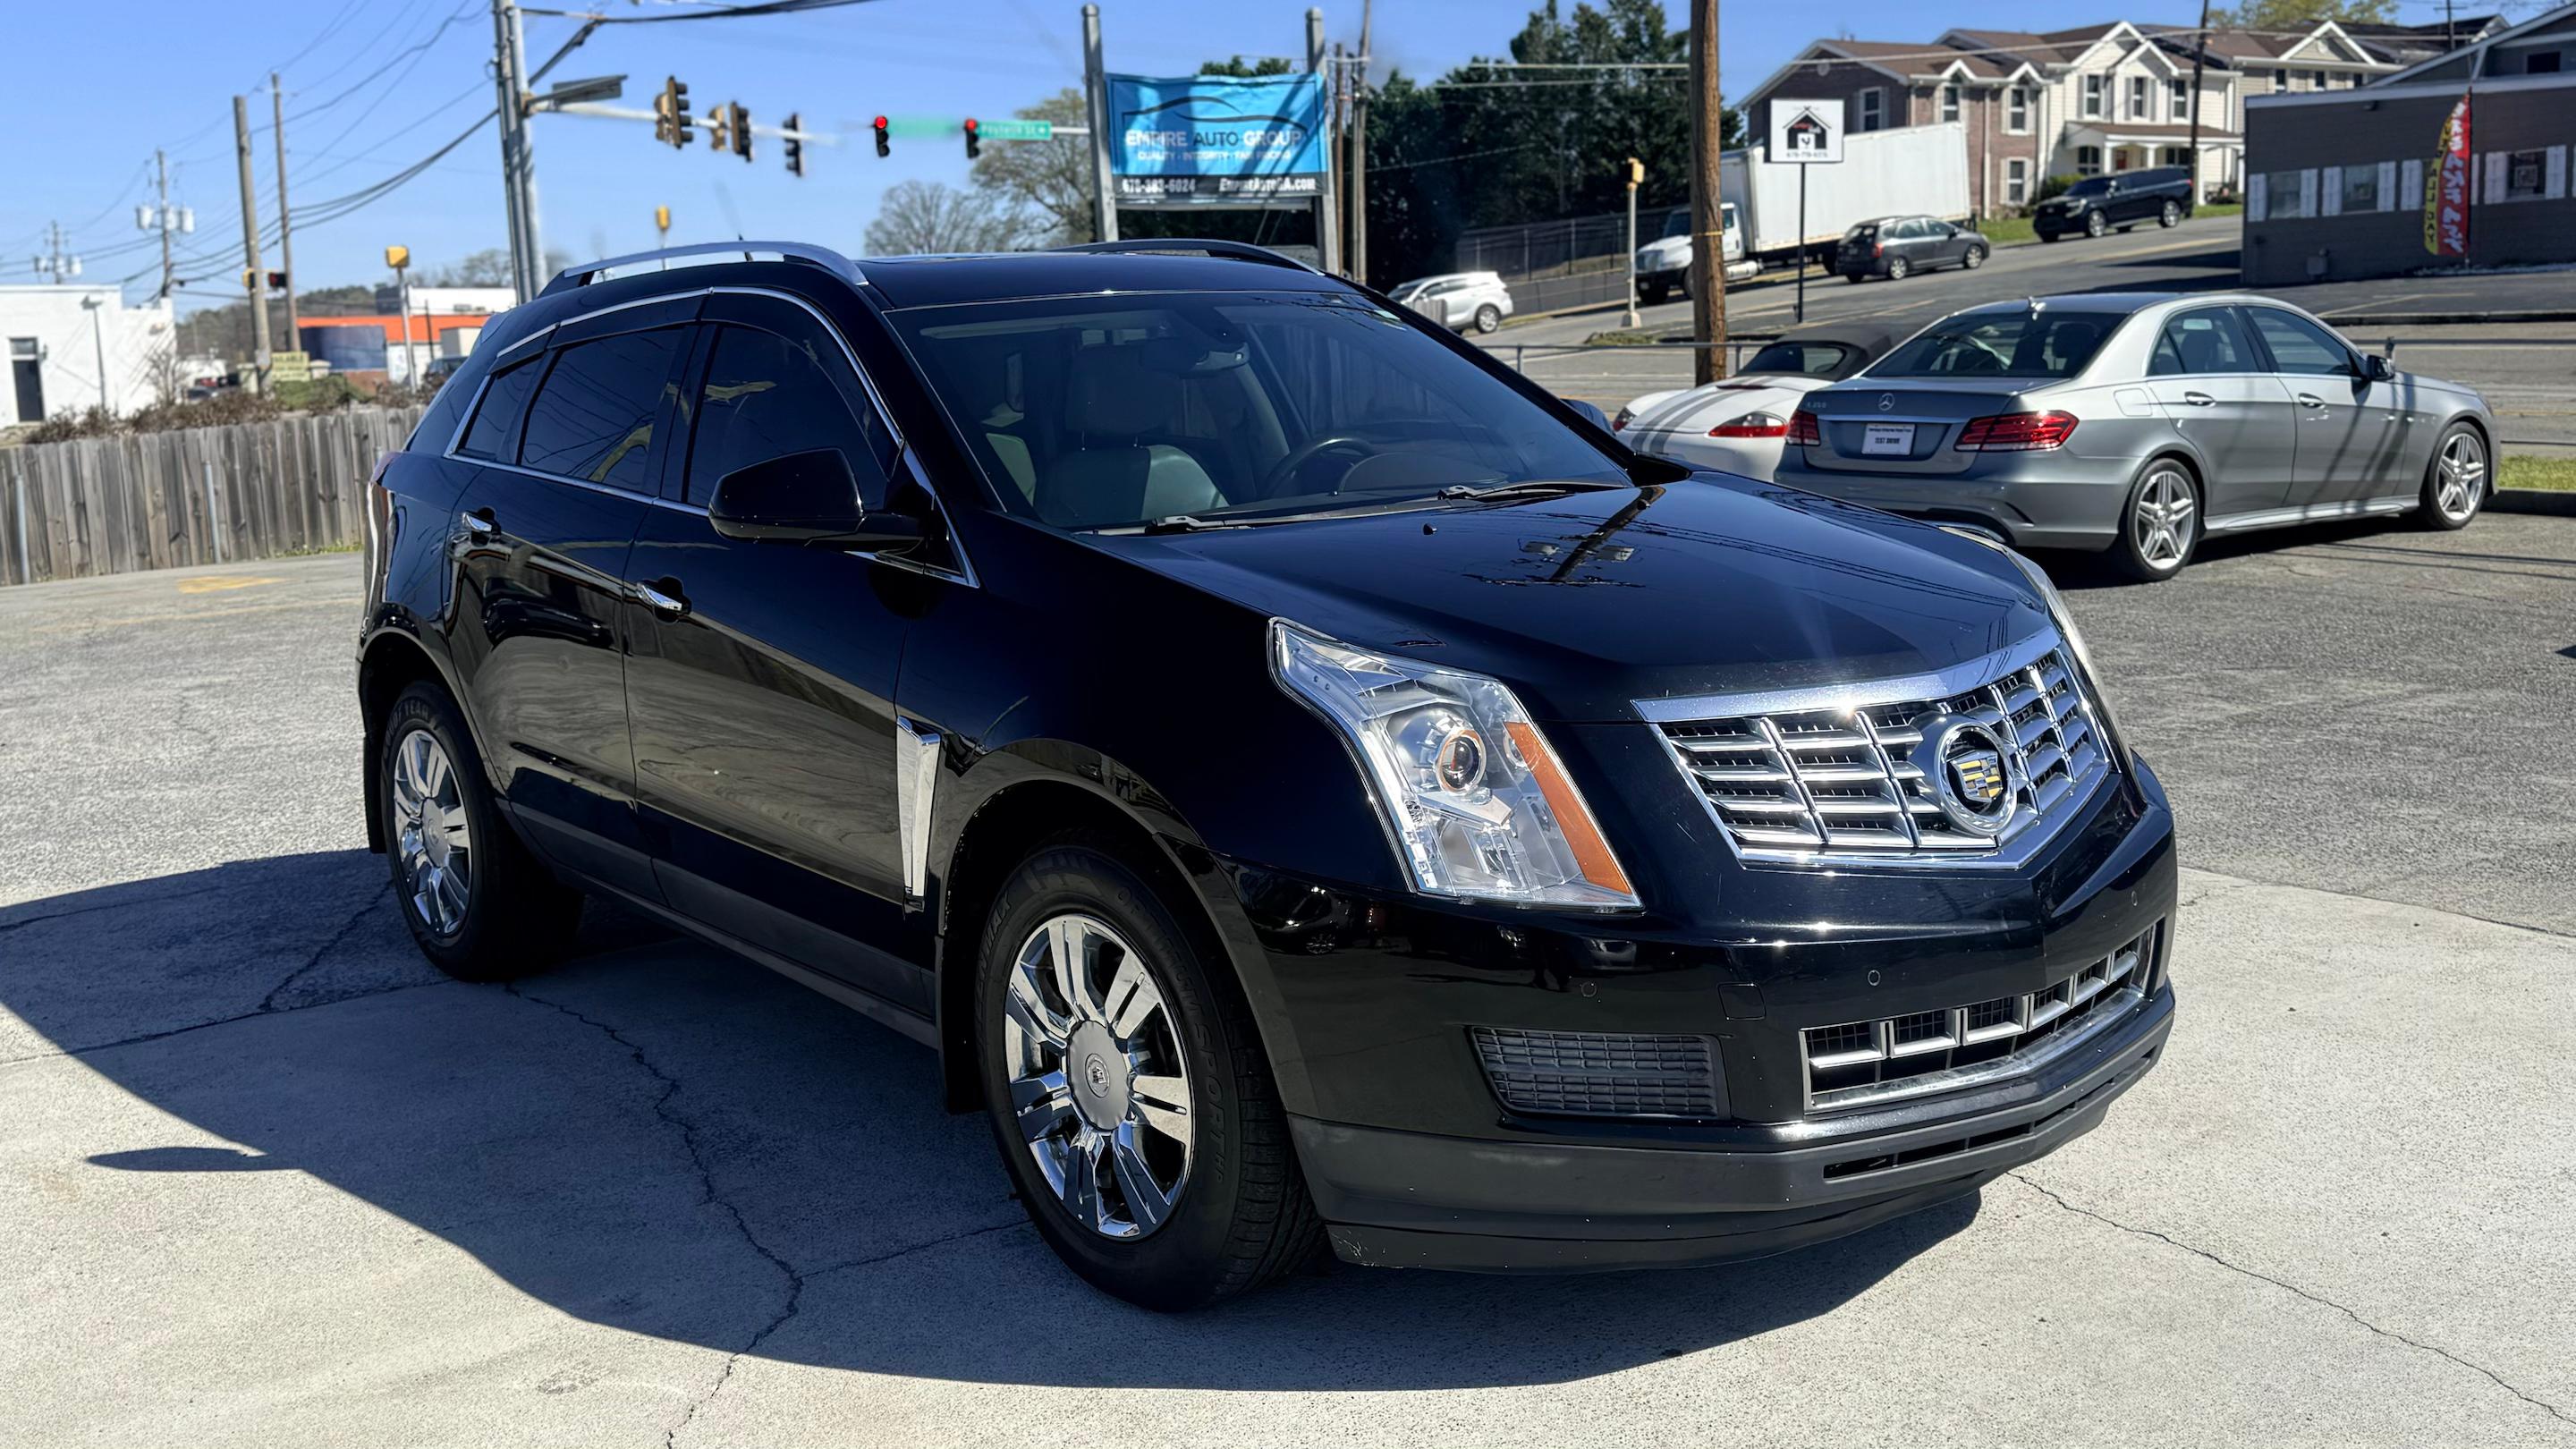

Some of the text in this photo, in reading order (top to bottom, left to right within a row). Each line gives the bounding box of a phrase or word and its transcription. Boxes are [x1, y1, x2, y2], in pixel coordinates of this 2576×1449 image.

[1125, 130, 1302, 147] EMPIRE AUTO GROUP
[1137, 151, 1177, 161] QUALITY
[1193, 1022, 1228, 1150] SPORT
